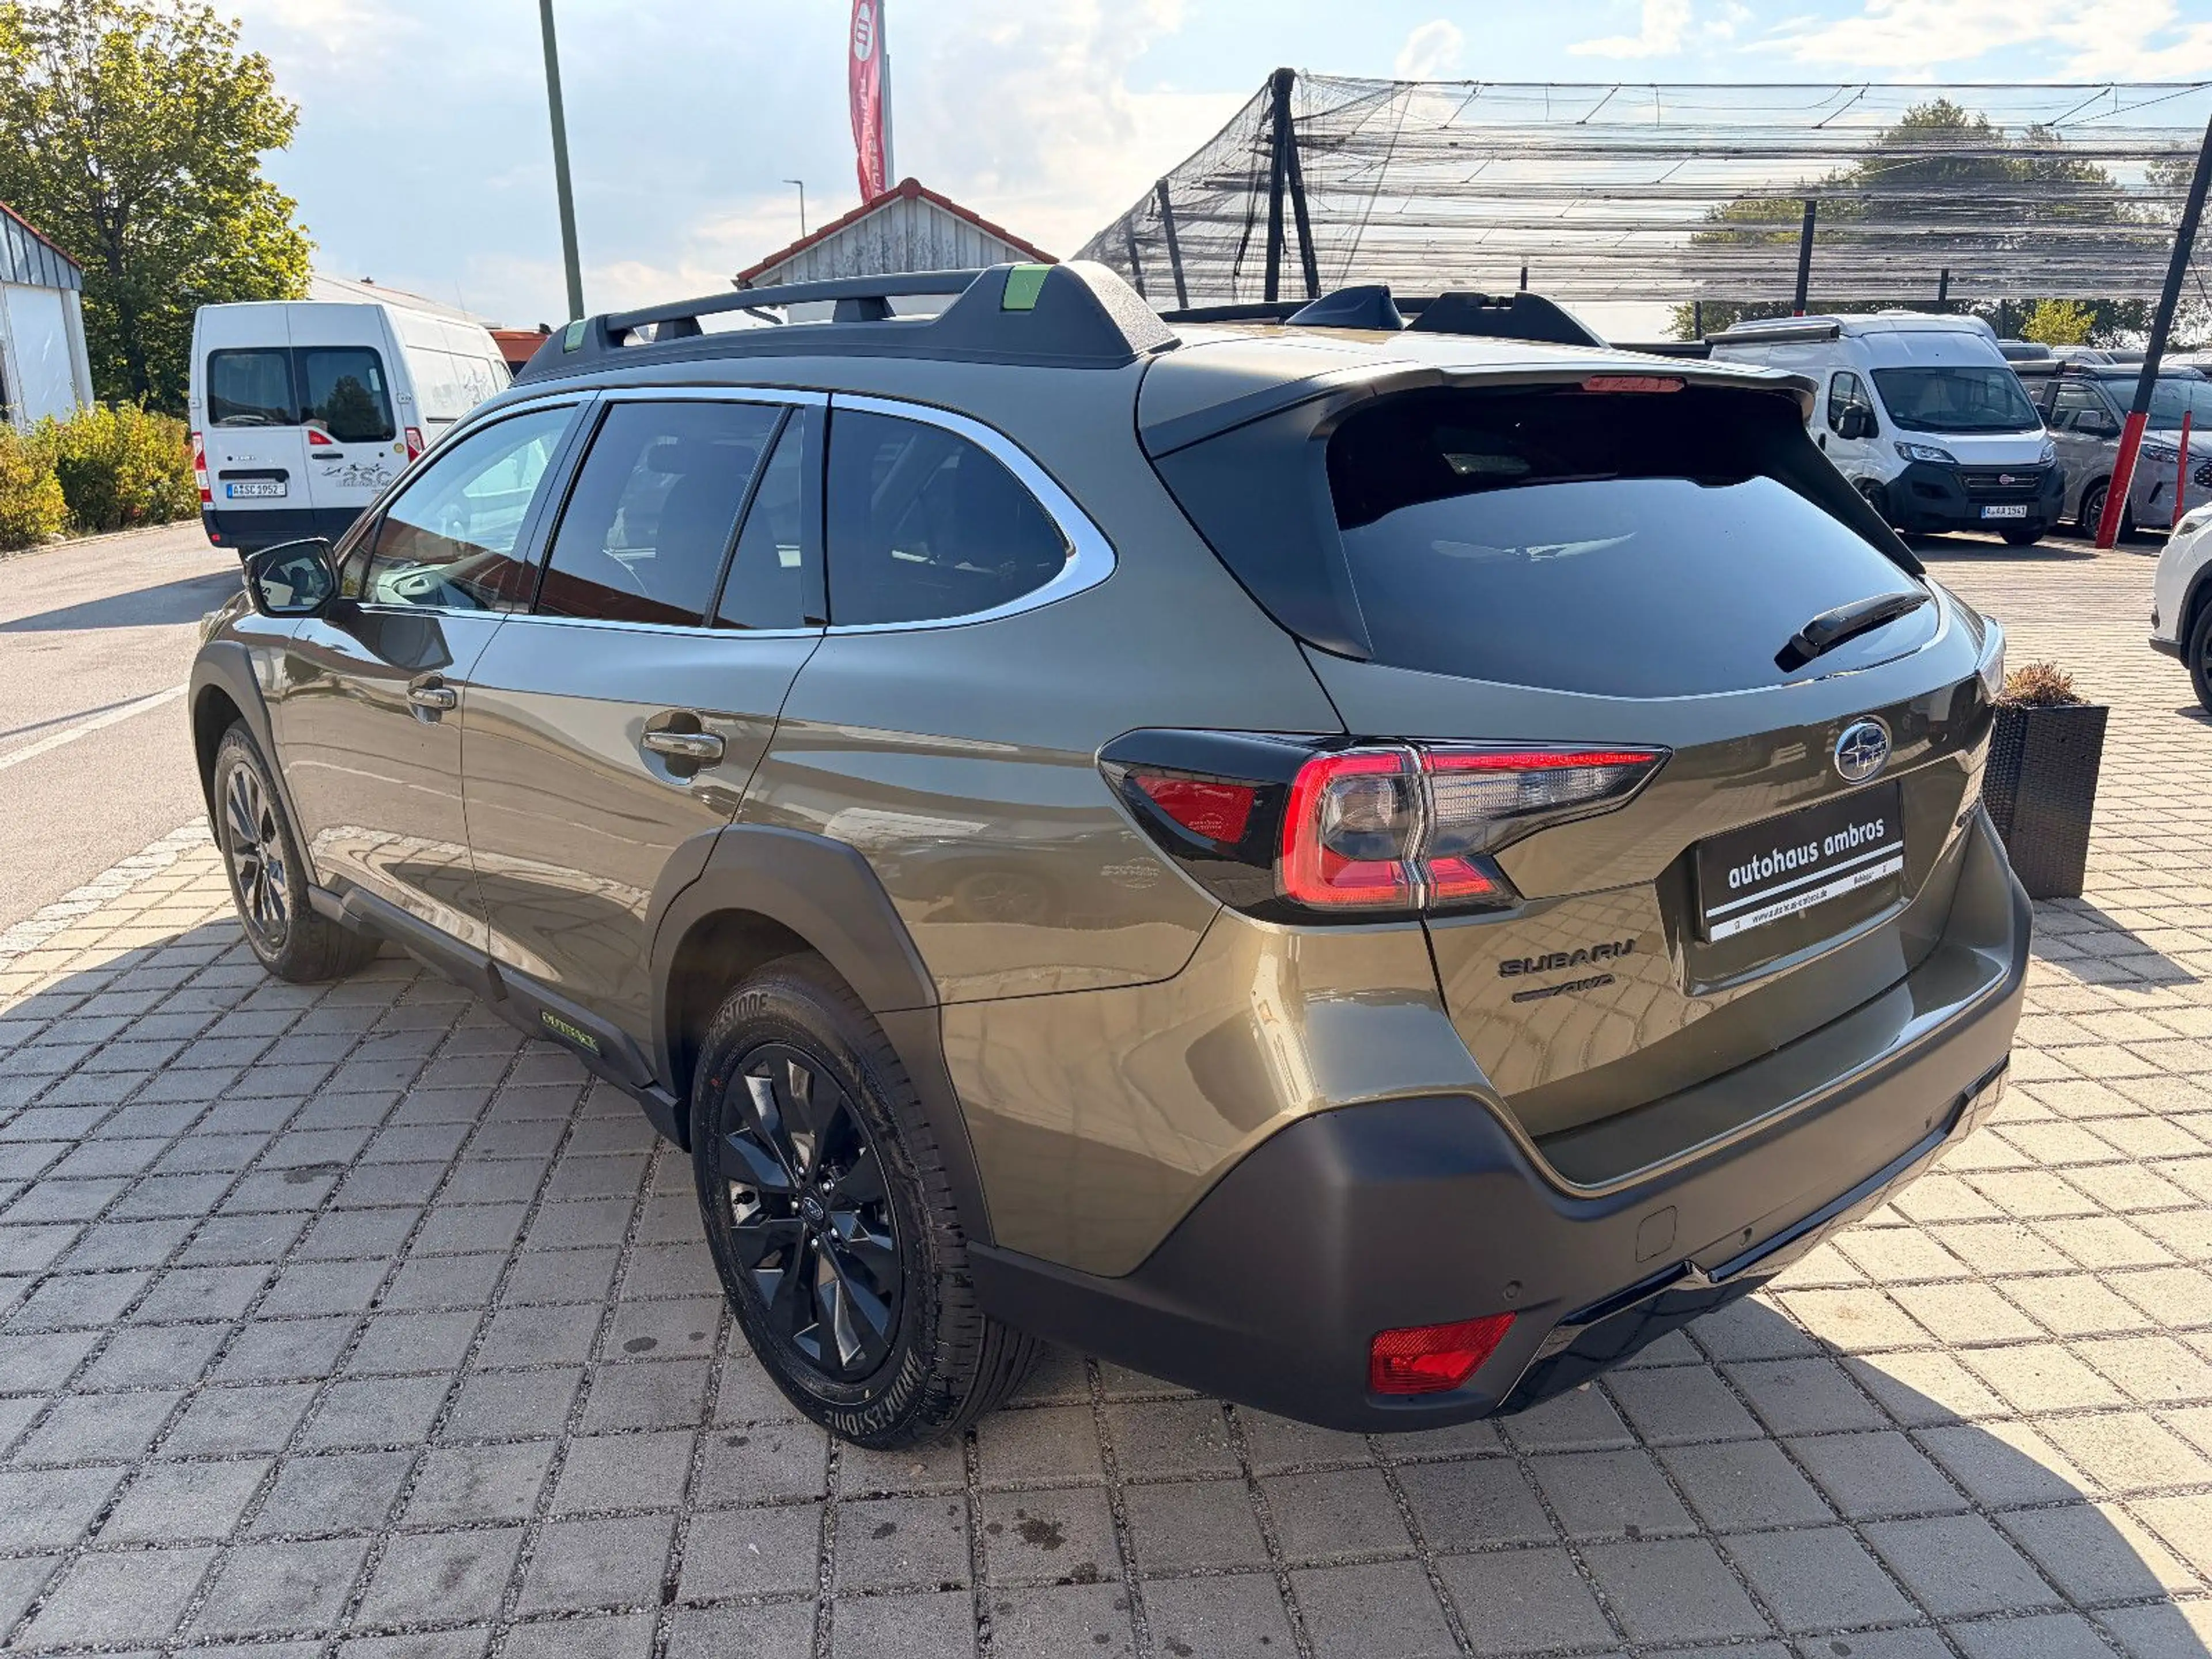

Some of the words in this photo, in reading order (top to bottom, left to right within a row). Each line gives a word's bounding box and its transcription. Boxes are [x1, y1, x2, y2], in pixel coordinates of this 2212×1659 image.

[1728, 839, 1819, 889] autohaus
[1823, 817, 1884, 857] ambros
[1498, 938, 1636, 978] SUBARU
[824, 1344, 923, 1436] BRIDGESTONE
